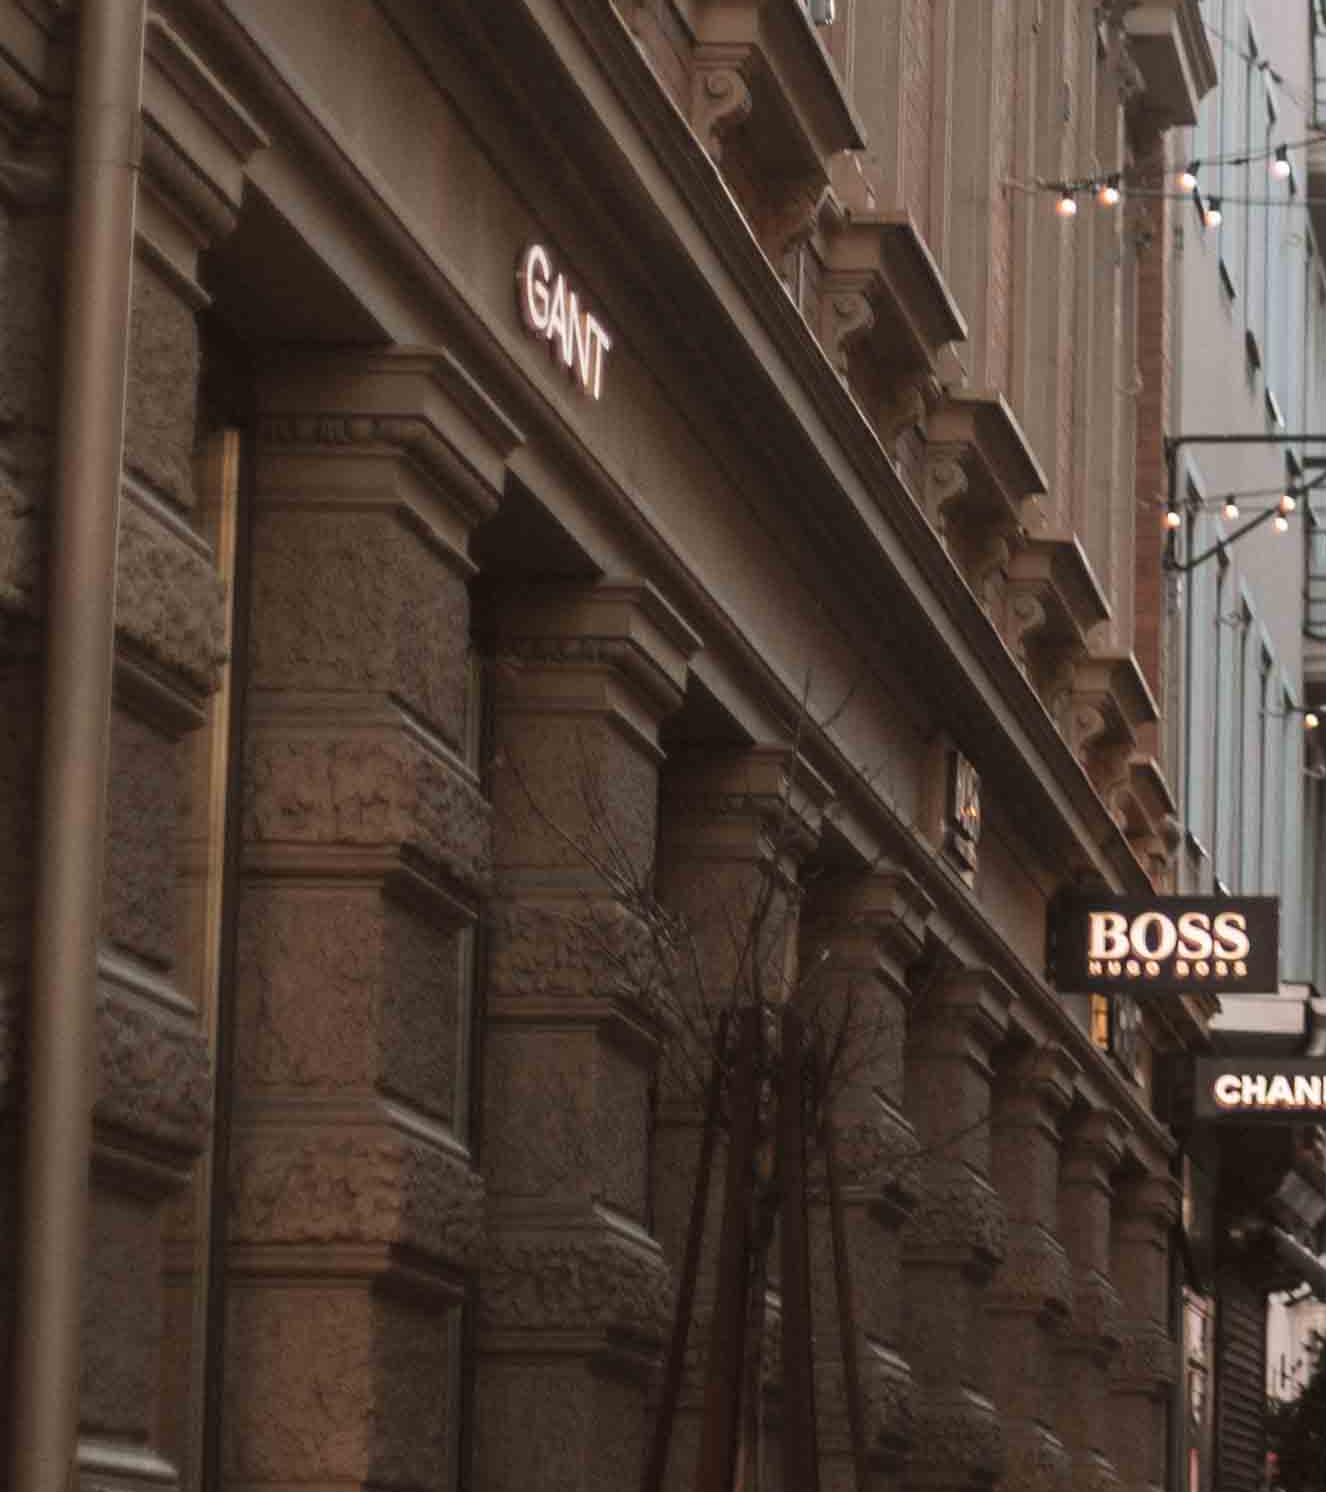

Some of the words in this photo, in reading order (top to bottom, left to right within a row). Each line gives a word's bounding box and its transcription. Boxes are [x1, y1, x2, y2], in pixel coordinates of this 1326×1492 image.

[523, 243, 614, 400] GANT
[1088, 911, 1250, 960] BOSS
[1088, 960, 1160, 977] HUGO
[1174, 960, 1248, 977] BOSS
